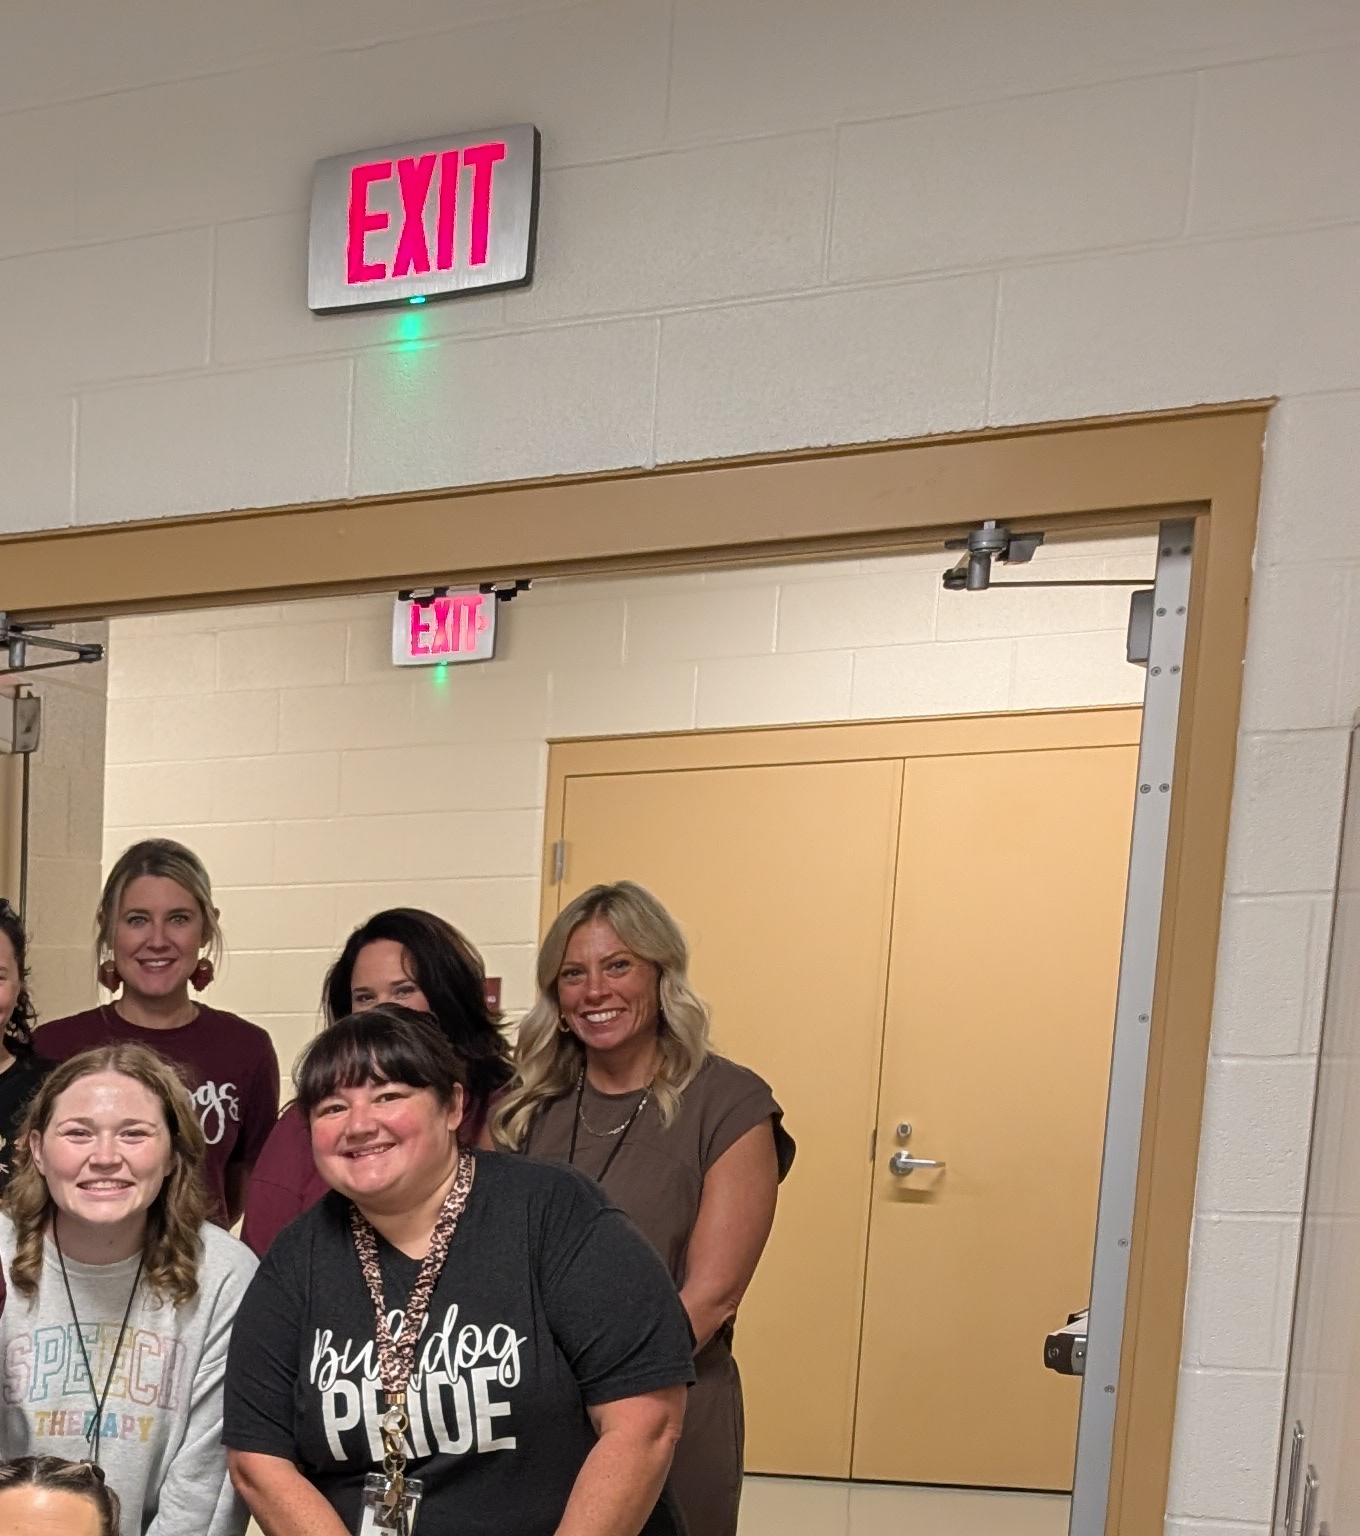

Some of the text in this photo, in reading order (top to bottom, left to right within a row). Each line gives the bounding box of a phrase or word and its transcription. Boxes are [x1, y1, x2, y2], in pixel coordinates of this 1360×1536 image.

[345, 142, 507, 285] EXIT
[410, 597, 483, 657] EXIT
[34, 1410, 155, 1443] THERAPY
